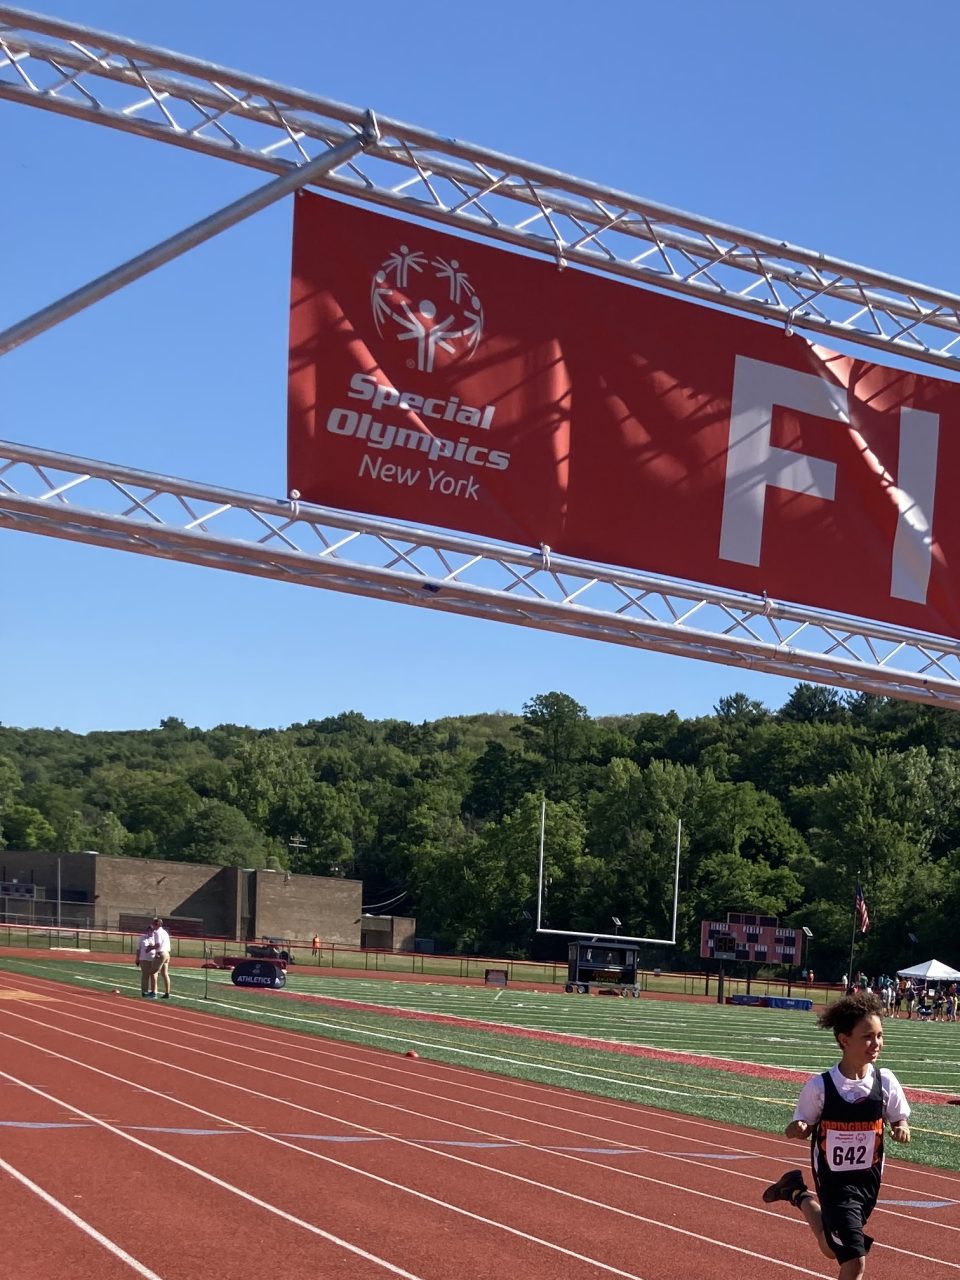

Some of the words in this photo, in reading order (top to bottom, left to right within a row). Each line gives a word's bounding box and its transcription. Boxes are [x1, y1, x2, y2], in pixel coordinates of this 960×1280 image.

[348, 372, 497, 431] Special
[326, 407, 511, 472] Olympics
[358, 453, 420, 487] New
[427, 468, 481, 501] York
[237, 975, 271, 984] ATHLETICS
[832, 1145, 867, 1166] 642
